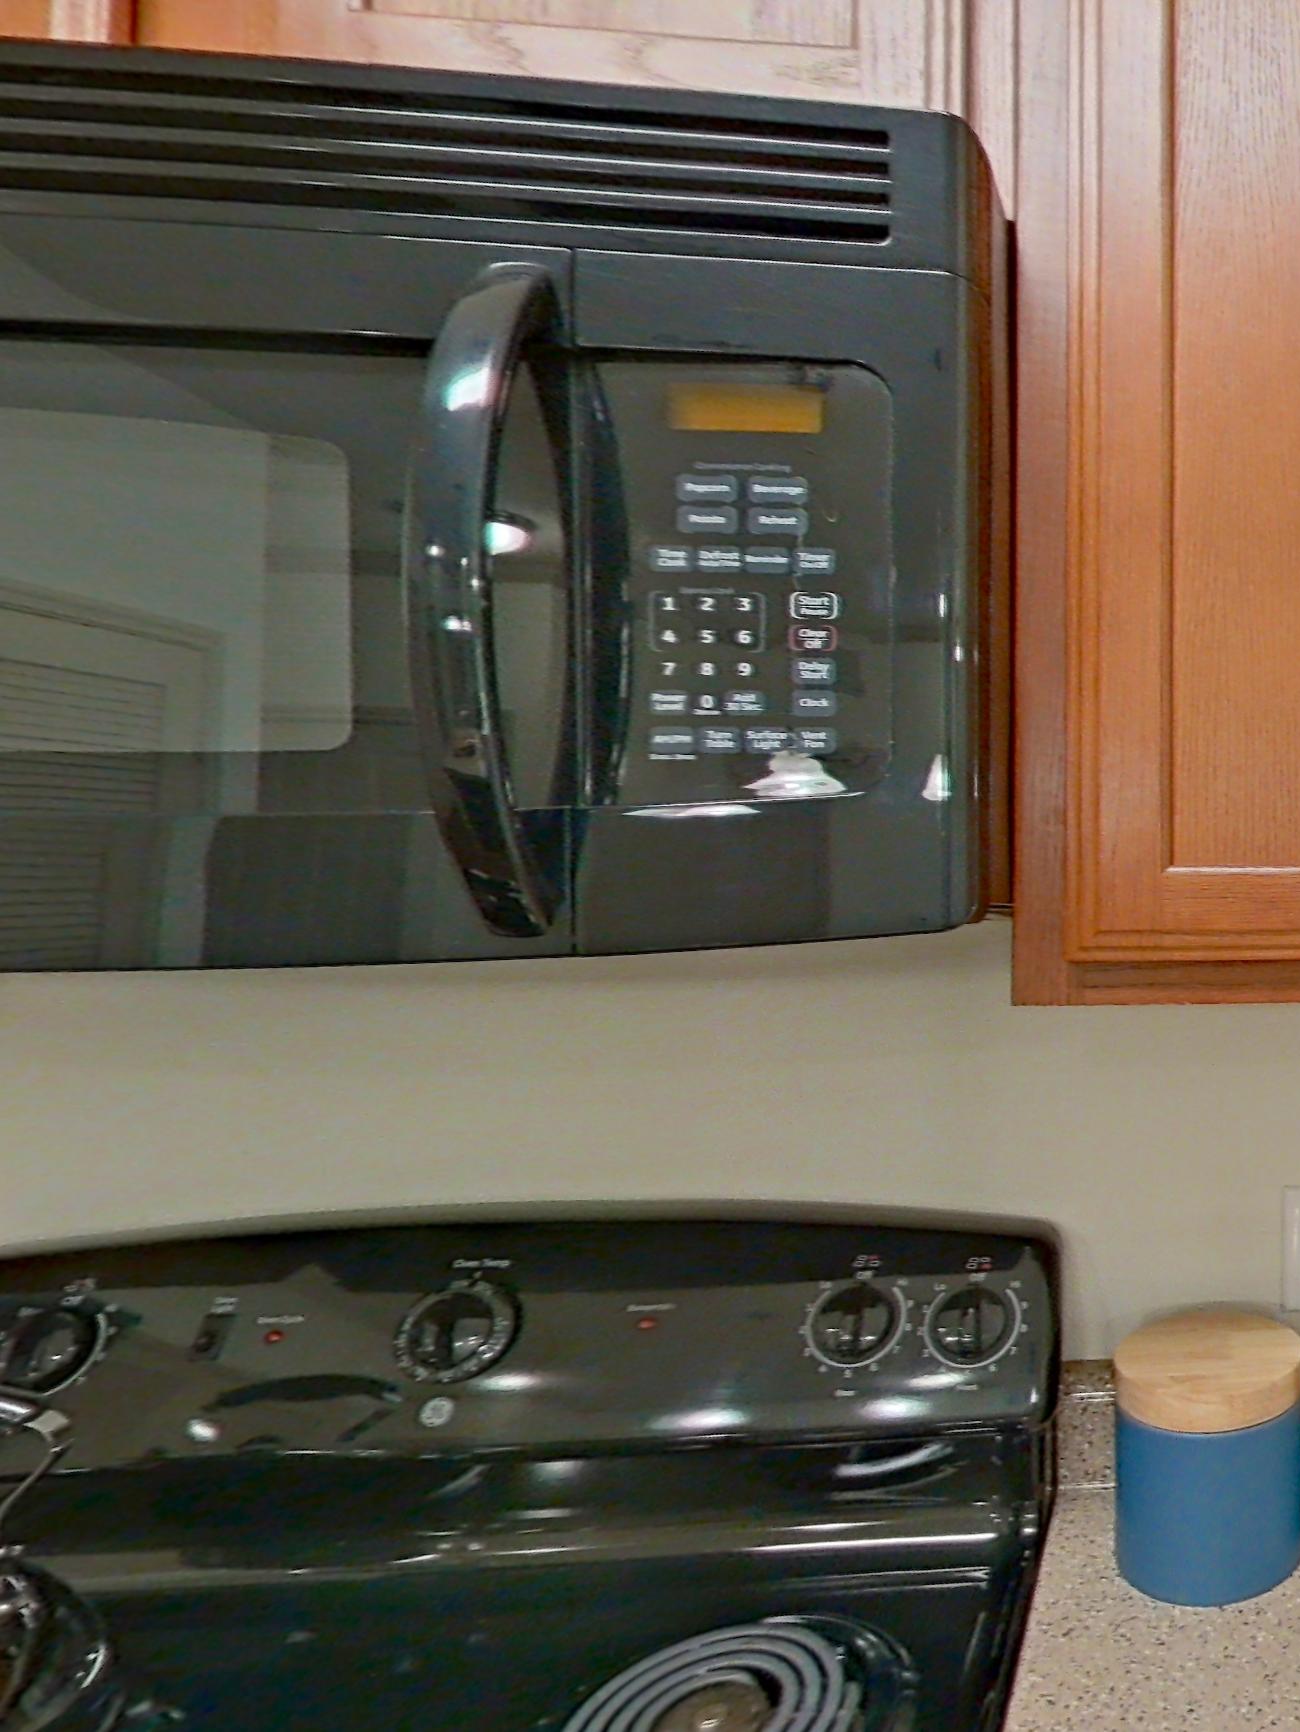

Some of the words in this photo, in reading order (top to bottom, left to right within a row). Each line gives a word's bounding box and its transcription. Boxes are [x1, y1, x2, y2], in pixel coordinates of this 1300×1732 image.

[662, 597, 679, 611] 1
[700, 597, 716, 611] 2
[736, 597, 752, 611] 3
[798, 595, 830, 606] Start
[661, 629, 678, 643] 4
[700, 629, 716, 644] 5
[737, 629, 752, 644] 6
[661, 662, 677, 676] 7
[699, 662, 715, 676] 8
[737, 662, 752, 676] 9
[799, 670, 830, 679] Start
[699, 694, 715, 709] 0
[799, 698, 830, 708] Clock
